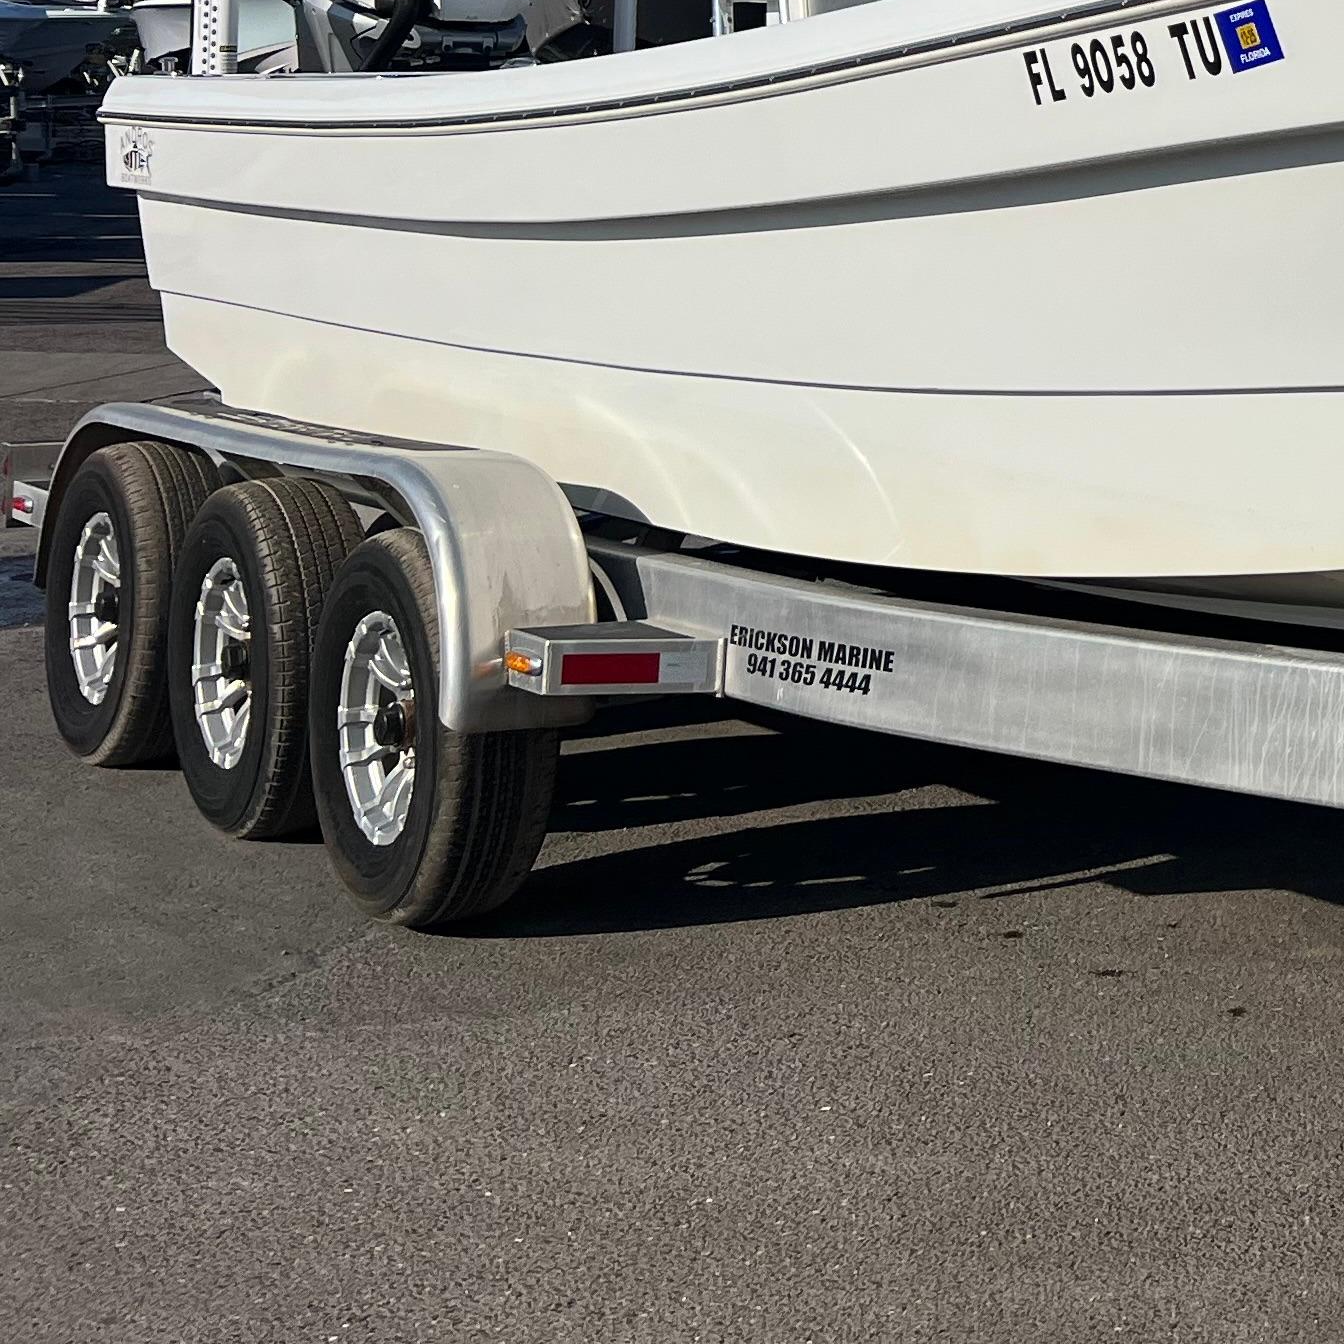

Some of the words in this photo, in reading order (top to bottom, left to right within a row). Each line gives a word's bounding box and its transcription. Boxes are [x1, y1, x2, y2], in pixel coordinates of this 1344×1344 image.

[1022, 47, 1067, 106] FL
[1070, 30, 1156, 97] 9058
[1167, 16, 1222, 80] TU
[1240, 47, 1271, 64] FLORIDA
[730, 624, 814, 659] ERICKSON
[817, 640, 895, 672] MARINE
[746, 653, 777, 678] 941
[778, 659, 817, 686] 365
[818, 667, 872, 695] 4444
